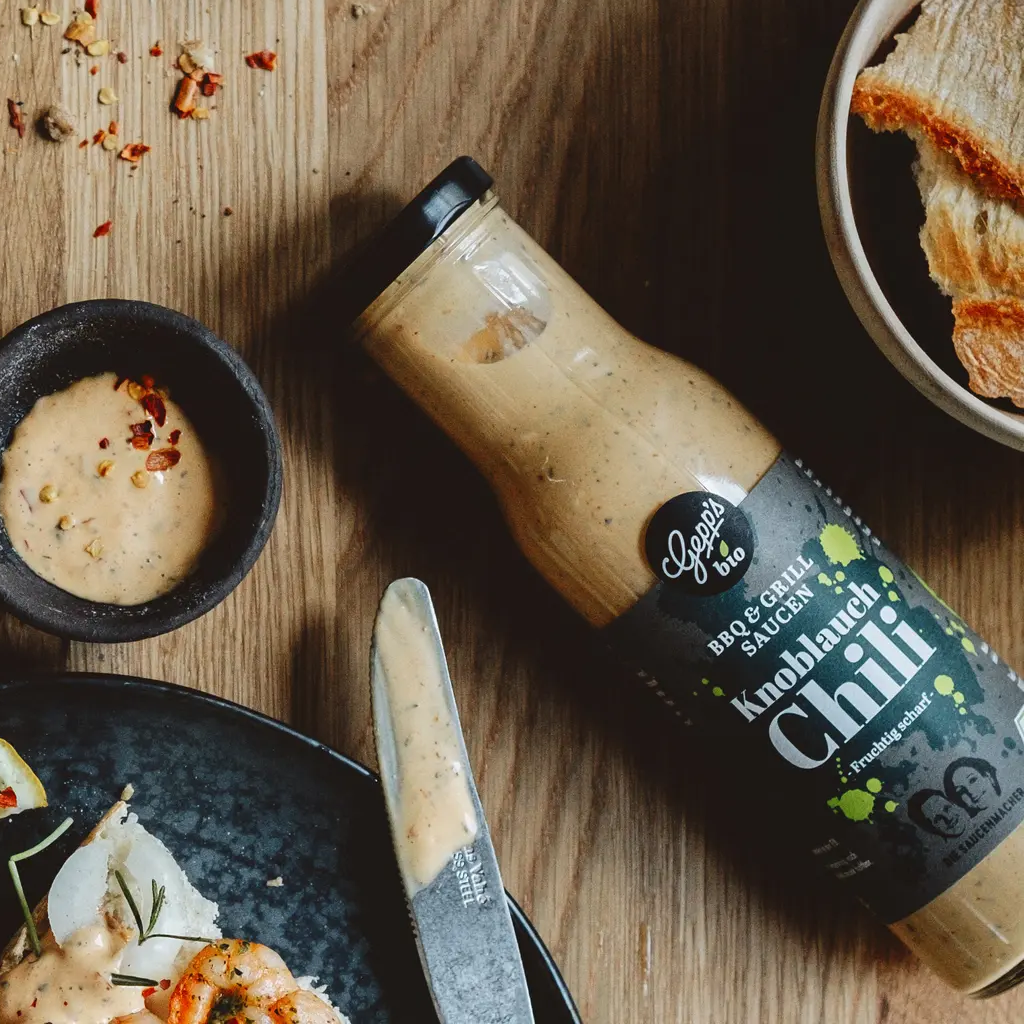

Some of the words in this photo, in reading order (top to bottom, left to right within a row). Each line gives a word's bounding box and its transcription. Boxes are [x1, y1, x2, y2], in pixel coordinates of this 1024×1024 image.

[662, 497, 725, 585] Gepp's
[712, 545, 746, 577] bio
[707, 620, 751, 657] BBQ
[744, 606, 761, 624] &
[760, 555, 814, 608] GRILL
[741, 583, 815, 658] SAUCEN
[729, 581, 882, 723] Knoblauch
[768, 605, 938, 770] Chili
[850, 729, 903, 775] Fruchtig
[897, 692, 932, 733] scharf
[456, 870, 476, 909] STEEL
